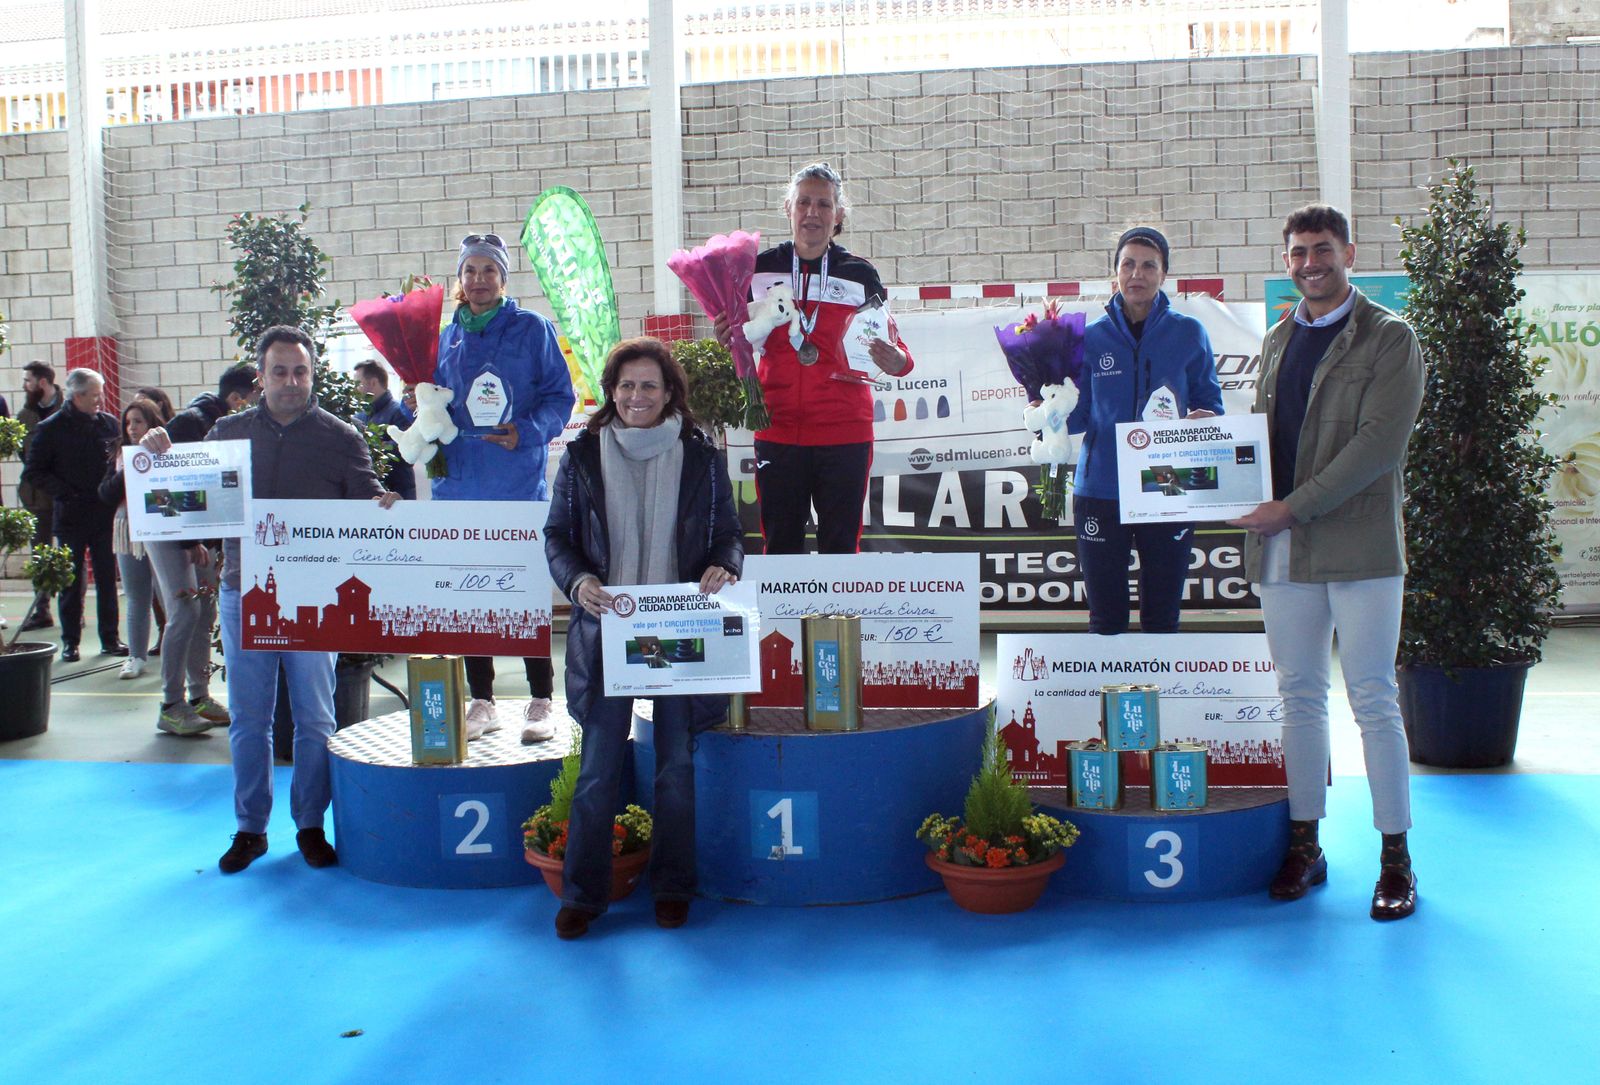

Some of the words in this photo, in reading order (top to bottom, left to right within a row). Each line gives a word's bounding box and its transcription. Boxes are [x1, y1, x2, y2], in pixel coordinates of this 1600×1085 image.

[1551, 304, 1577, 313] flores
[1579, 305, 1586, 313] y
[897, 378, 947, 391] Lucena
[971, 386, 1026, 401] DEPORTE
[1153, 429, 1179, 438] MEDIA
[1180, 426, 1220, 436] MARATÓN
[1154, 436, 1186, 444] CIUDAD
[1188, 434, 1198, 442] DE
[1200, 433, 1233, 441] LUCENA
[1162, 451, 1172, 459] por
[1178, 450, 1209, 458] CIRCUITO
[1210, 448, 1234, 456] TERMAL
[154, 460, 180, 468] CIUDAD
[191, 458, 219, 466] LUCENA
[292, 527, 335, 540] MEDIA
[338, 524, 404, 540] MARATÓN
[408, 528, 459, 540] CIUDAD
[463, 528, 481, 541] DE
[485, 529, 538, 542] LUCENA
[276, 554, 287, 562] La
[289, 554, 325, 564] cantidad
[327, 555, 340, 564] de:
[352, 548, 383, 562] Cien
[386, 548, 423, 563] Euros
[435, 580, 453, 589] EUR:
[460, 573, 491, 590] 100
[496, 572, 515, 590] €
[761, 579, 828, 594] MARATÓN
[832, 582, 884, 594] CIUDAD
[888, 581, 906, 593] DE
[910, 580, 965, 593] LUCENA
[638, 596, 666, 604] MEDIA
[666, 594, 708, 603] MARATÓN
[638, 603, 672, 612] CIUDAD
[674, 602, 686, 611] DE
[686, 602, 720, 610] LUCENA
[775, 602, 819, 616] Ciento
[824, 602, 894, 616] Cincuenta
[898, 602, 936, 615] Euros
[632, 622, 646, 630] vale
[646, 622, 658, 630] por
[664, 620, 695, 628] CIRCUITO
[696, 618, 722, 627] TERMAL
[885, 626, 918, 642] 150
[923, 624, 943, 642] €
[1052, 661, 1097, 673] MEDIA
[1101, 658, 1171, 672] MARATÓN
[1174, 660, 1228, 672] CIUDAD
[1232, 660, 1251, 672] DE
[1034, 689, 1044, 697] La
[1046, 688, 1086, 698] cantidad
[1088, 688, 1100, 698] de
[1192, 682, 1232, 695] Euros
[1204, 712, 1223, 721] EUR:
[1236, 706, 1260, 720] 50
[1267, 703, 1283, 721] €
[454, 800, 493, 855] 2
[765, 798, 803, 855] 1
[1143, 830, 1184, 888] 3
